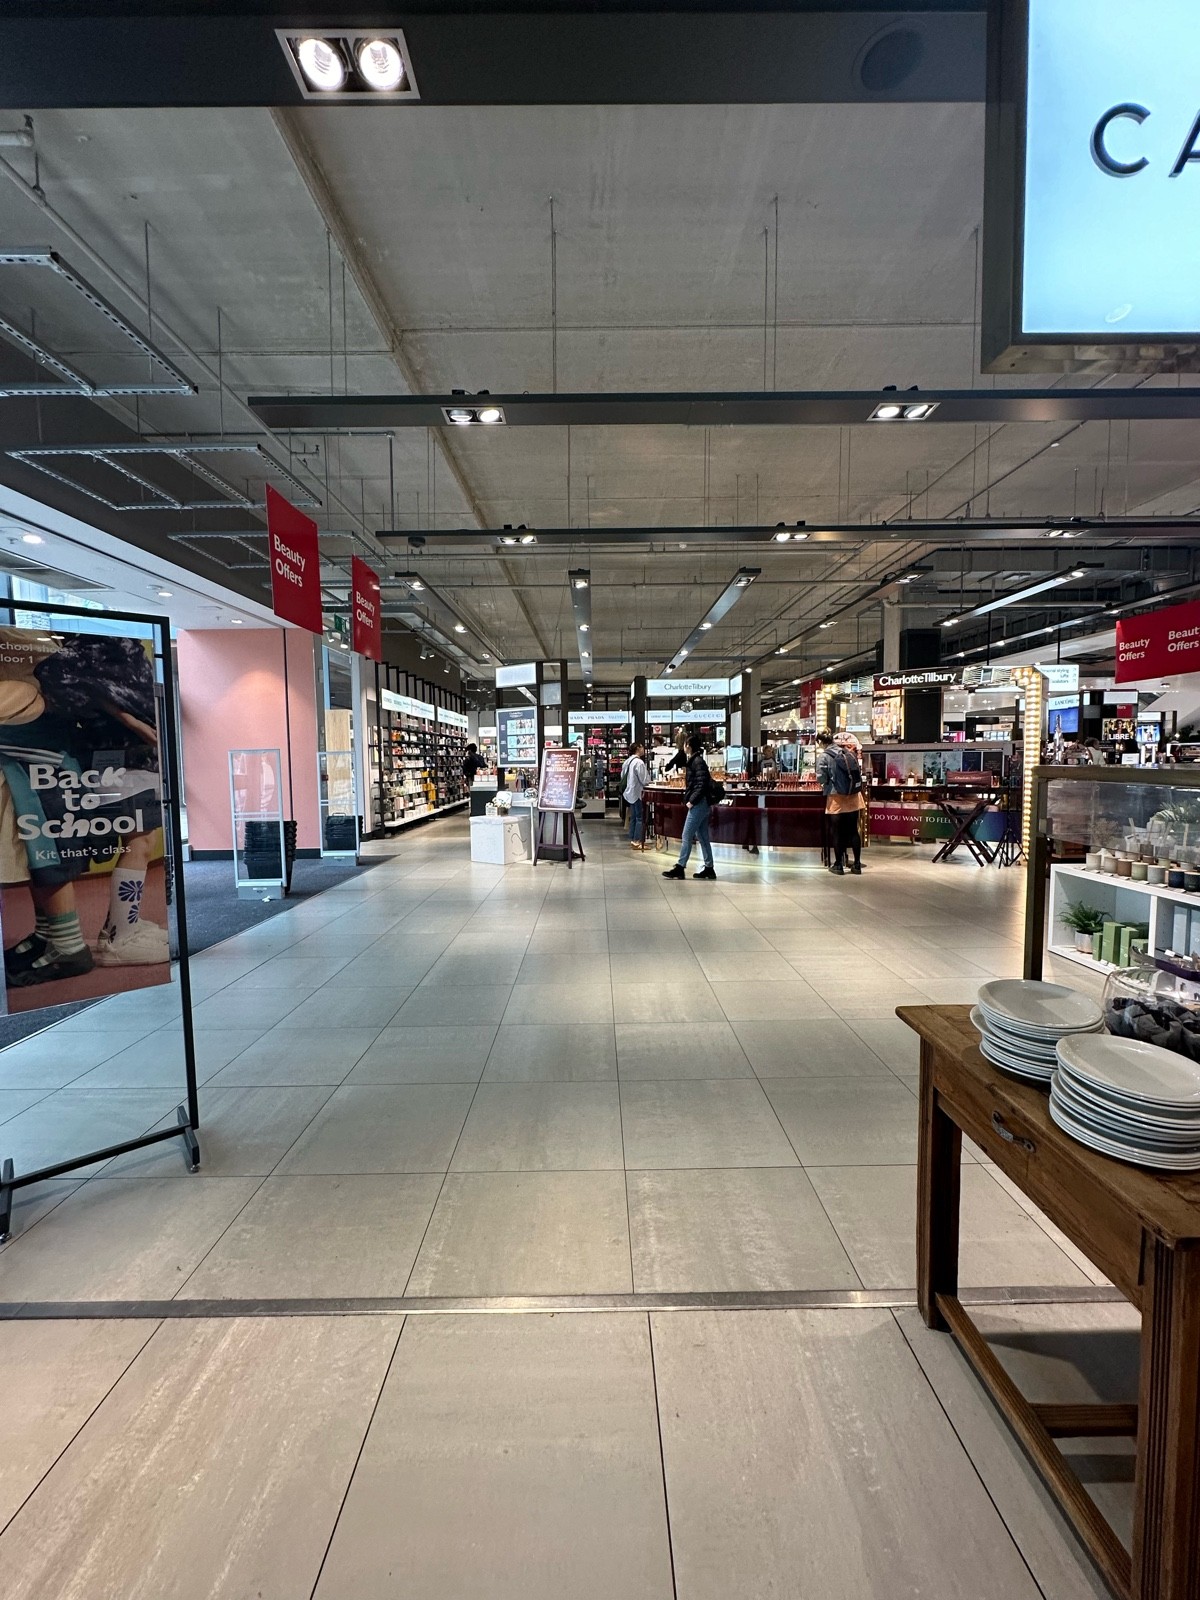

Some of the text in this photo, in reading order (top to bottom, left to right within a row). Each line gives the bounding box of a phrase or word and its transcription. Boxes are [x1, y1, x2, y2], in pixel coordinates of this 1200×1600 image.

[273, 533, 306, 572] Beauty
[275, 558, 303, 588] Offers
[356, 591, 375, 617] Beauty
[356, 609, 374, 629] Offers
[1168, 626, 1200, 640] Beaut
[0, 641, 33, 652] chool
[1119, 638, 1150, 651] Beauty
[1167, 640, 1200, 653] Offers
[0, 653, 34, 664] loor 1
[1118, 651, 1145, 662] Offers
[28, 764, 127, 790] Back
[61, 789, 101, 812] to
[17, 809, 144, 840] School
[902, 815, 923, 823] WANT
[35, 845, 132, 860] Kit that's class
